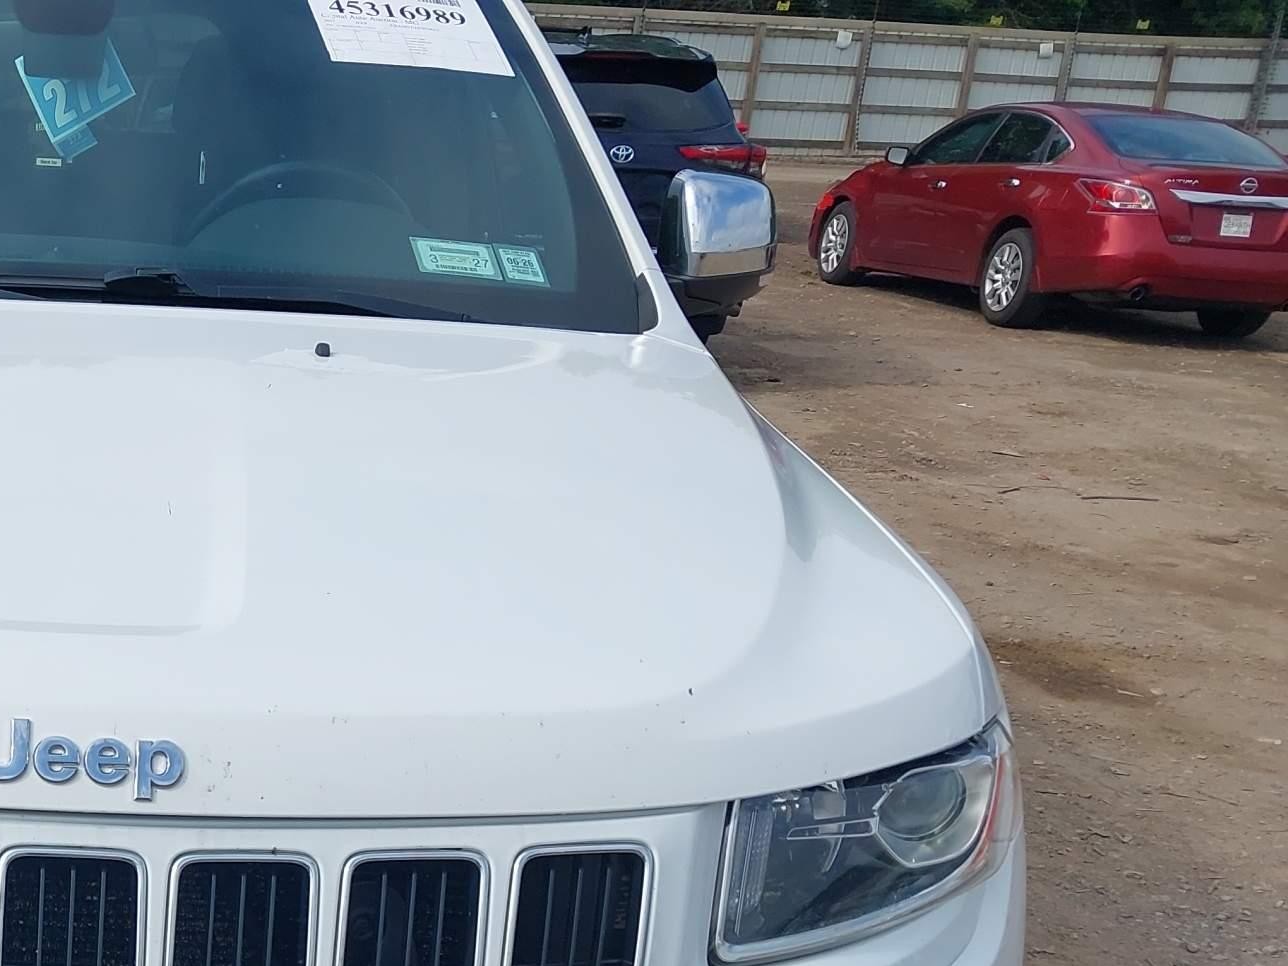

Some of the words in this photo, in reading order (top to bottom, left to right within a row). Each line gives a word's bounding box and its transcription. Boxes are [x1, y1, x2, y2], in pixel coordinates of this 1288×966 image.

[328, 0, 466, 26] 45316989
[429, 254, 439, 264] 3
[472, 258, 489, 269] 27
